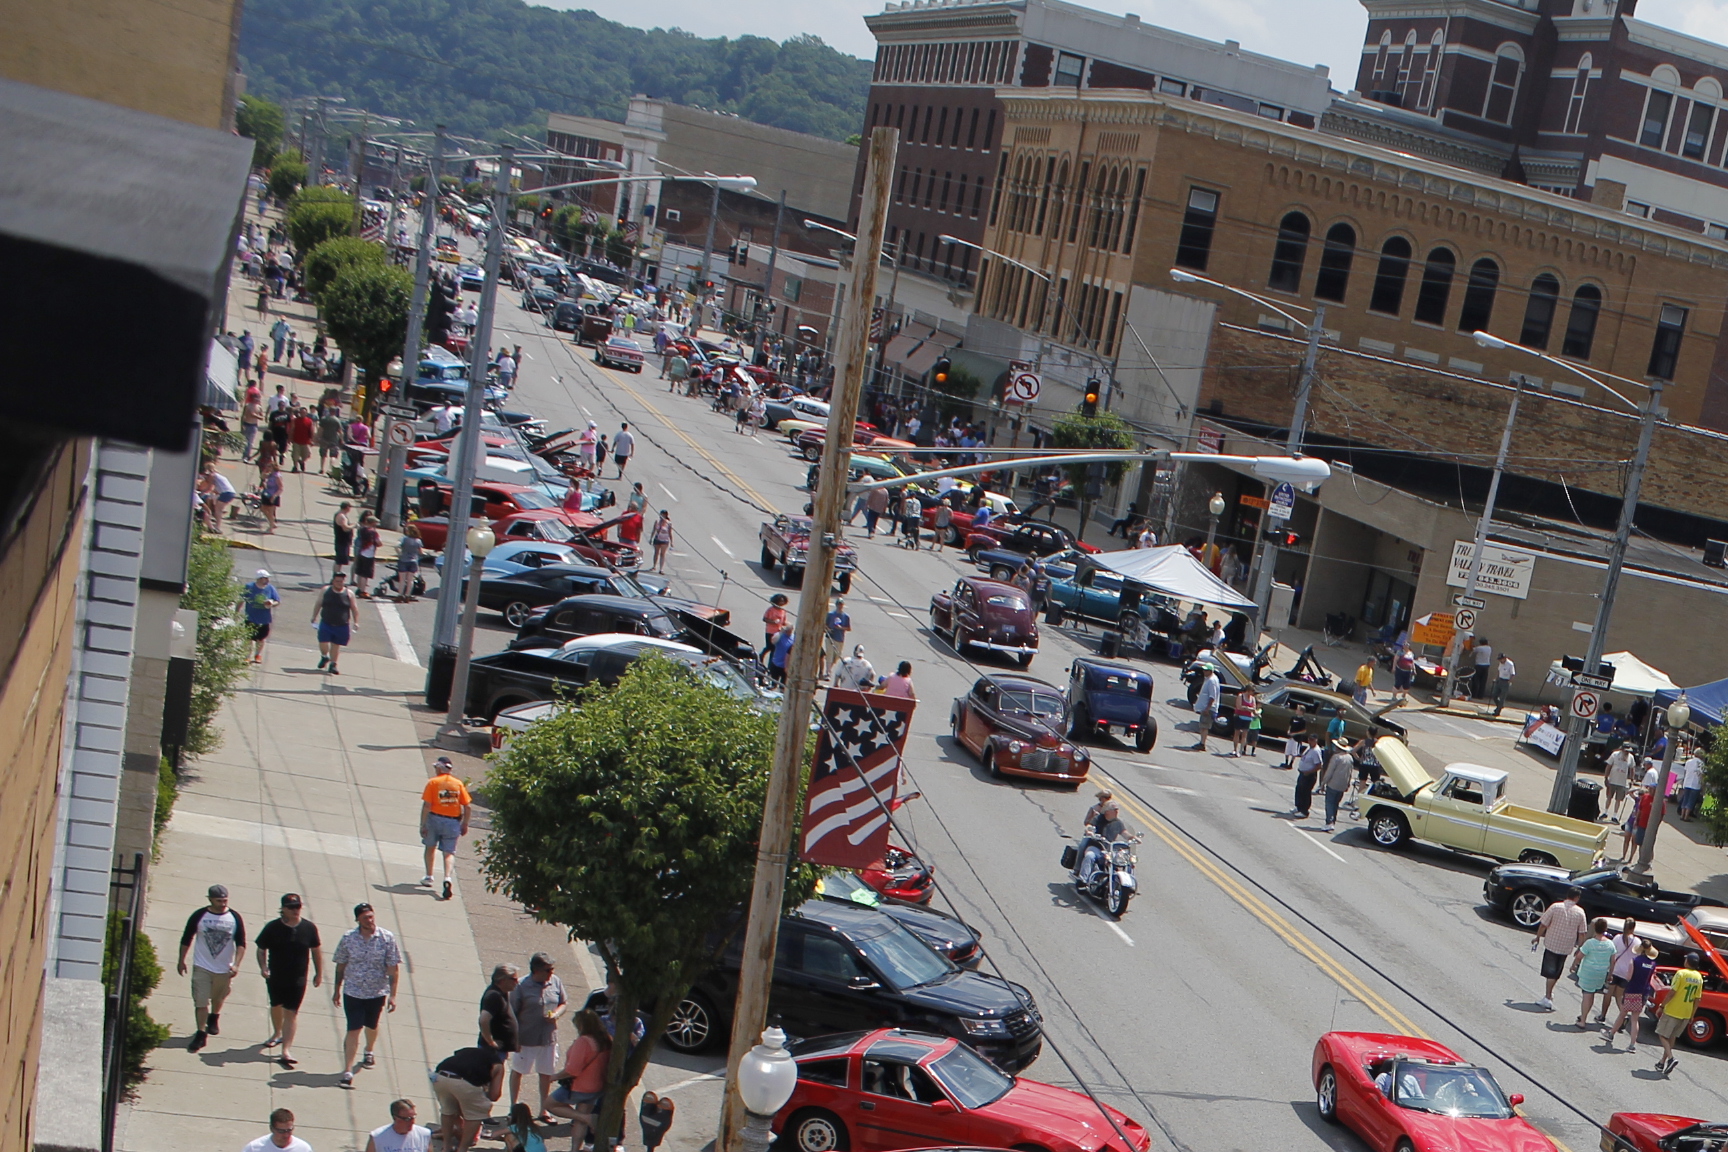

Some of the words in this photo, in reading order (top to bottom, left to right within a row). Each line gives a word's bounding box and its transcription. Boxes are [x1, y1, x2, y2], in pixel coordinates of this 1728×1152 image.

[1456, 544, 1472, 556] TRI
[1454, 557, 1486, 573] VALLY
[1486, 564, 1515, 578] TRAVEL
[1581, 676, 1592, 684] ONE
[1684, 983, 1698, 1002] 10
